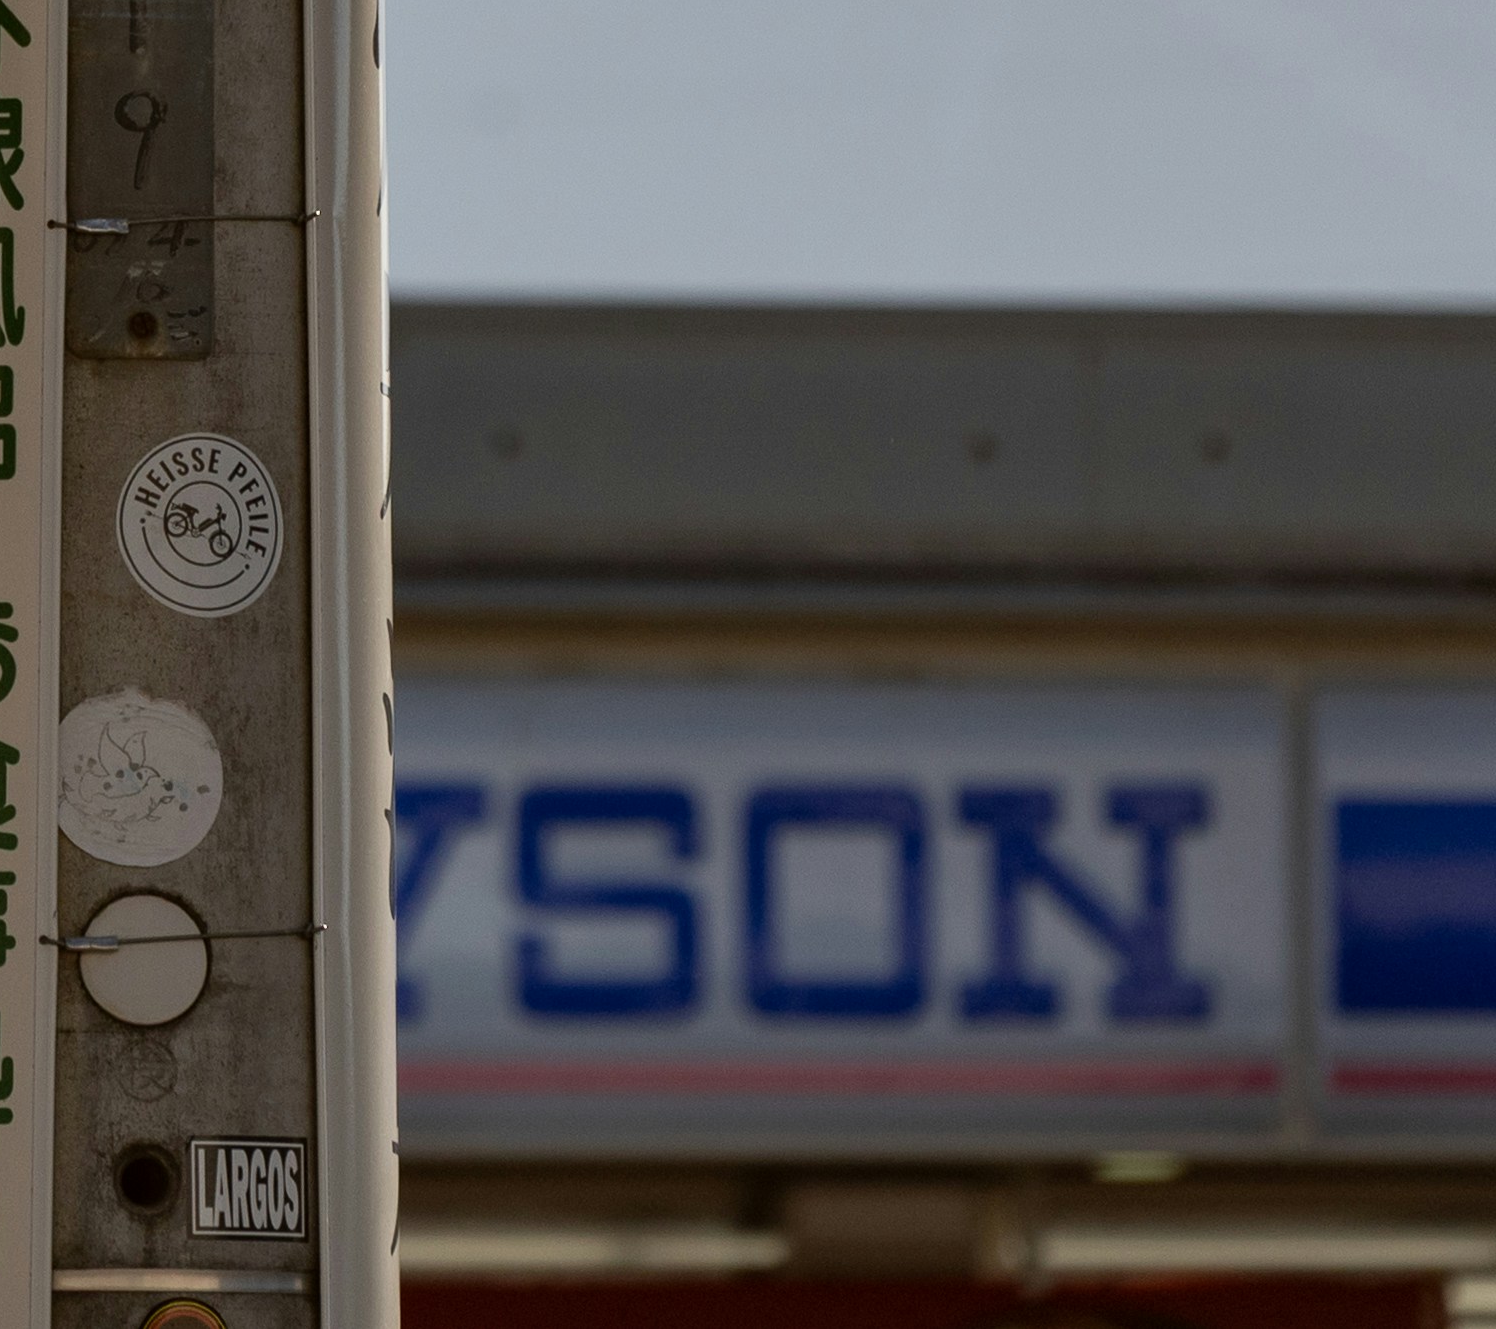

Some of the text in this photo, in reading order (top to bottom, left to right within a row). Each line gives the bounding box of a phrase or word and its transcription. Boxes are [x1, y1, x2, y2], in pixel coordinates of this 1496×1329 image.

[134, 447, 270, 558] HEISSE PFEILE
[197, 1148, 300, 1231] LARGOS
